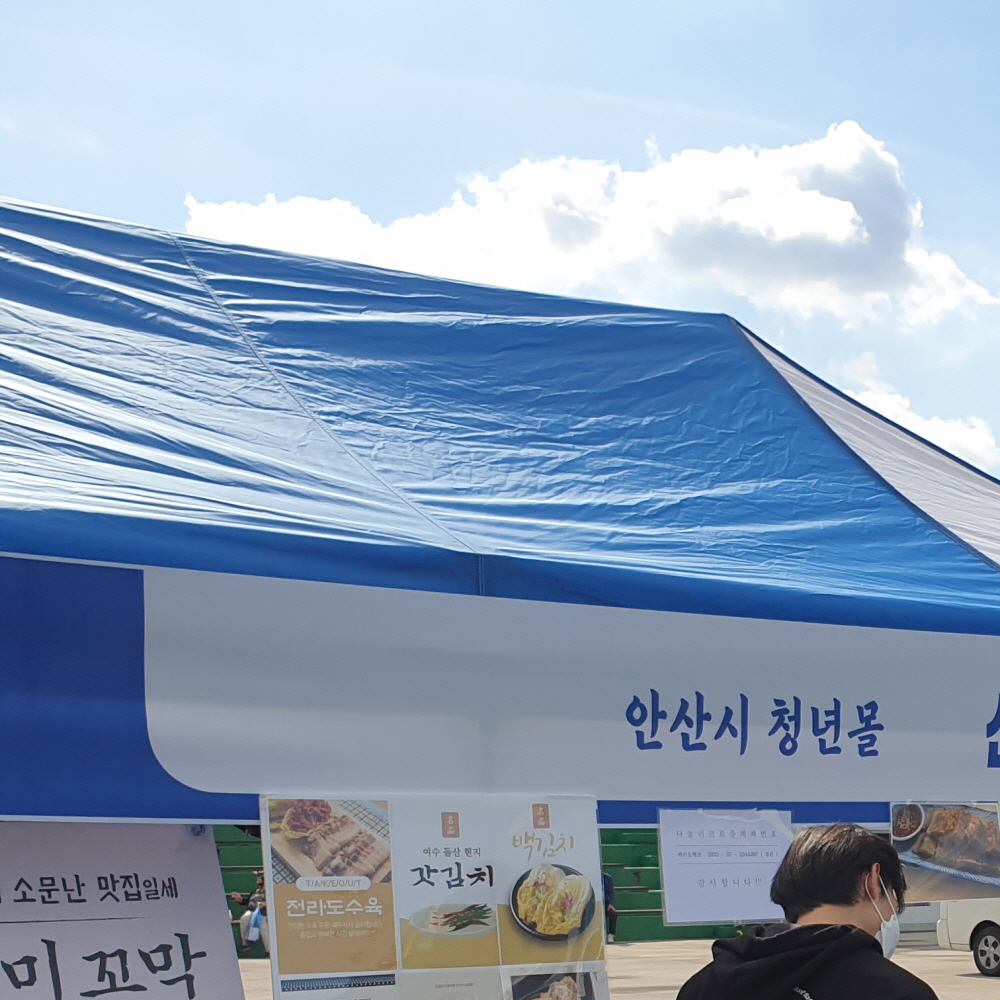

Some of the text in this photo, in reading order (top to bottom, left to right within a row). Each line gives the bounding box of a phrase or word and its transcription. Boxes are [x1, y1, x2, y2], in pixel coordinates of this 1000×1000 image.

[625, 688, 884, 758] 안산시 청년몰
[422, 847, 481, 858] 여수 돌산 현지
[512, 831, 575, 861] 백김치
[13, 872, 178, 904] 소문난 맛집일세
[410, 861, 494, 889] 갓김치
[286, 897, 382, 917] 전라도수육
[79, 932, 207, 1000] 꼬막
